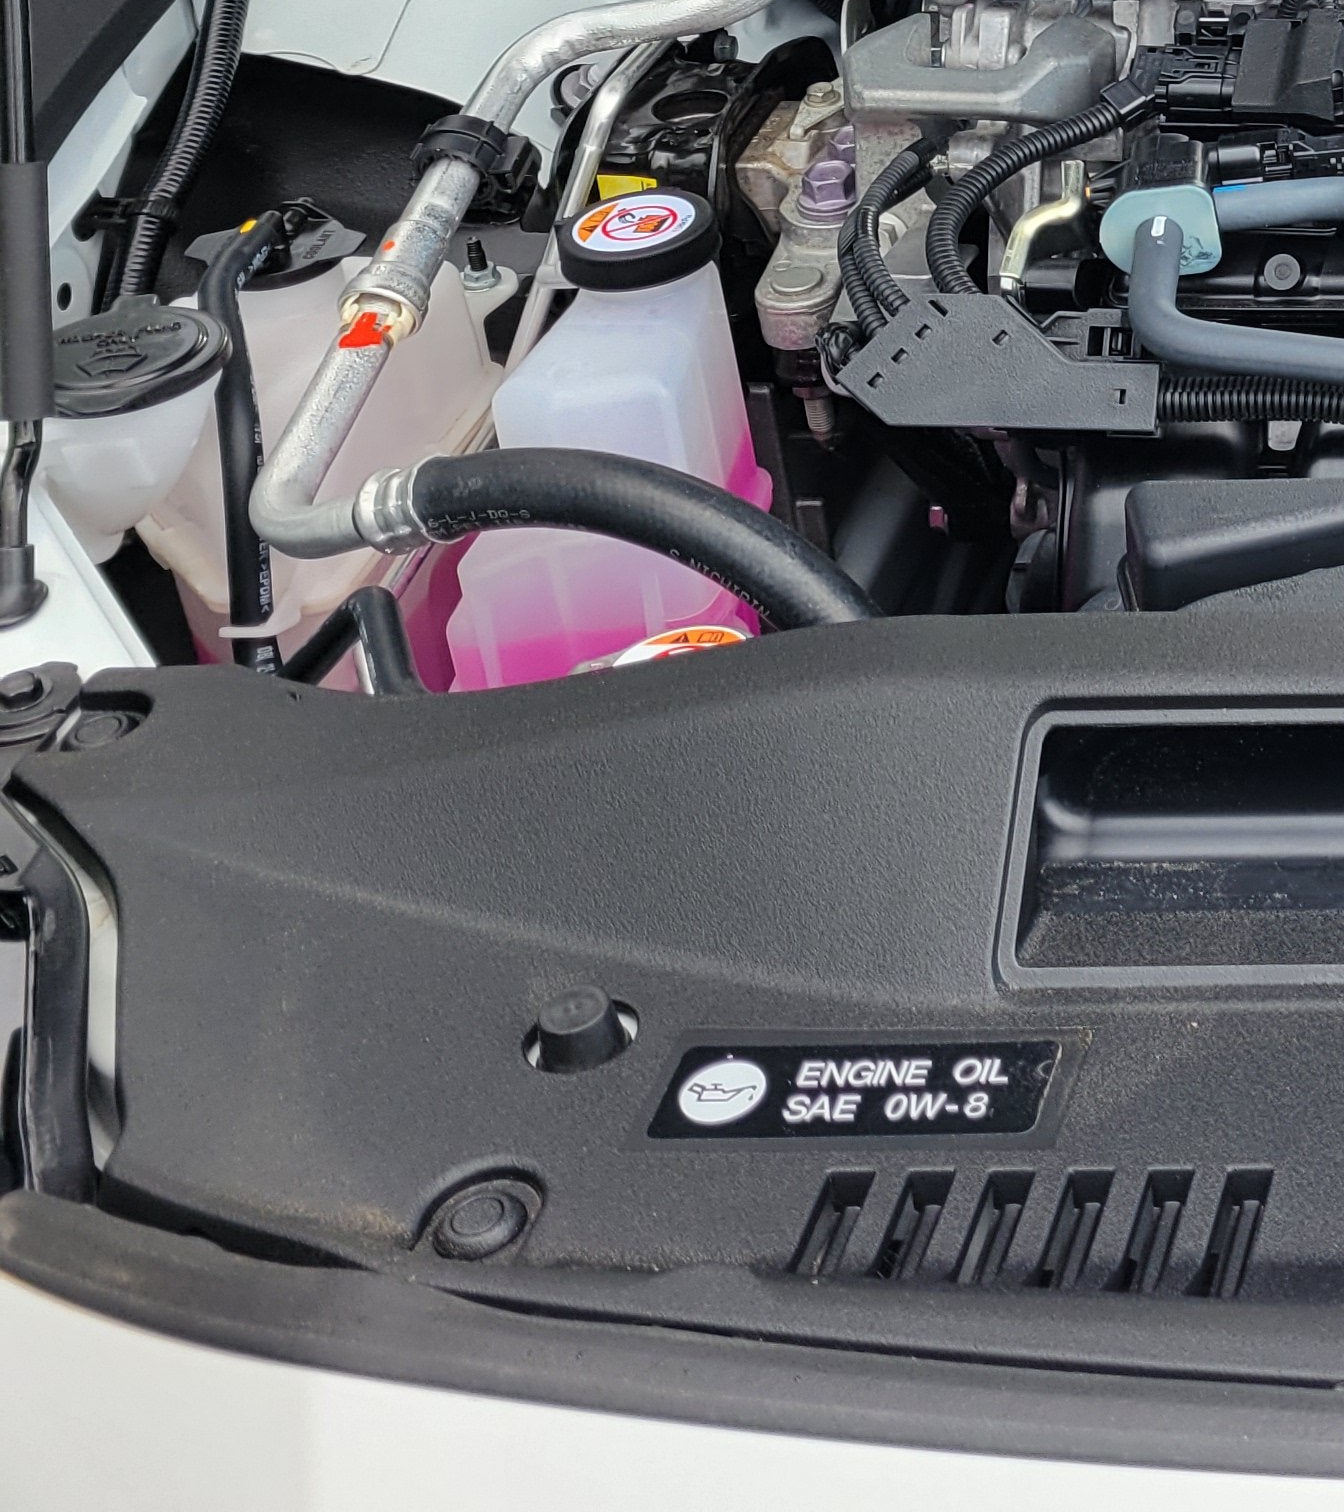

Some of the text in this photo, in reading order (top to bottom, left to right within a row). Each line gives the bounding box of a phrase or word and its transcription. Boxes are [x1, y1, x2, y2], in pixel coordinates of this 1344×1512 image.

[795, 1058, 1010, 1087] ENGINE OIL
[782, 1093, 991, 1122] SAE 0W-8
